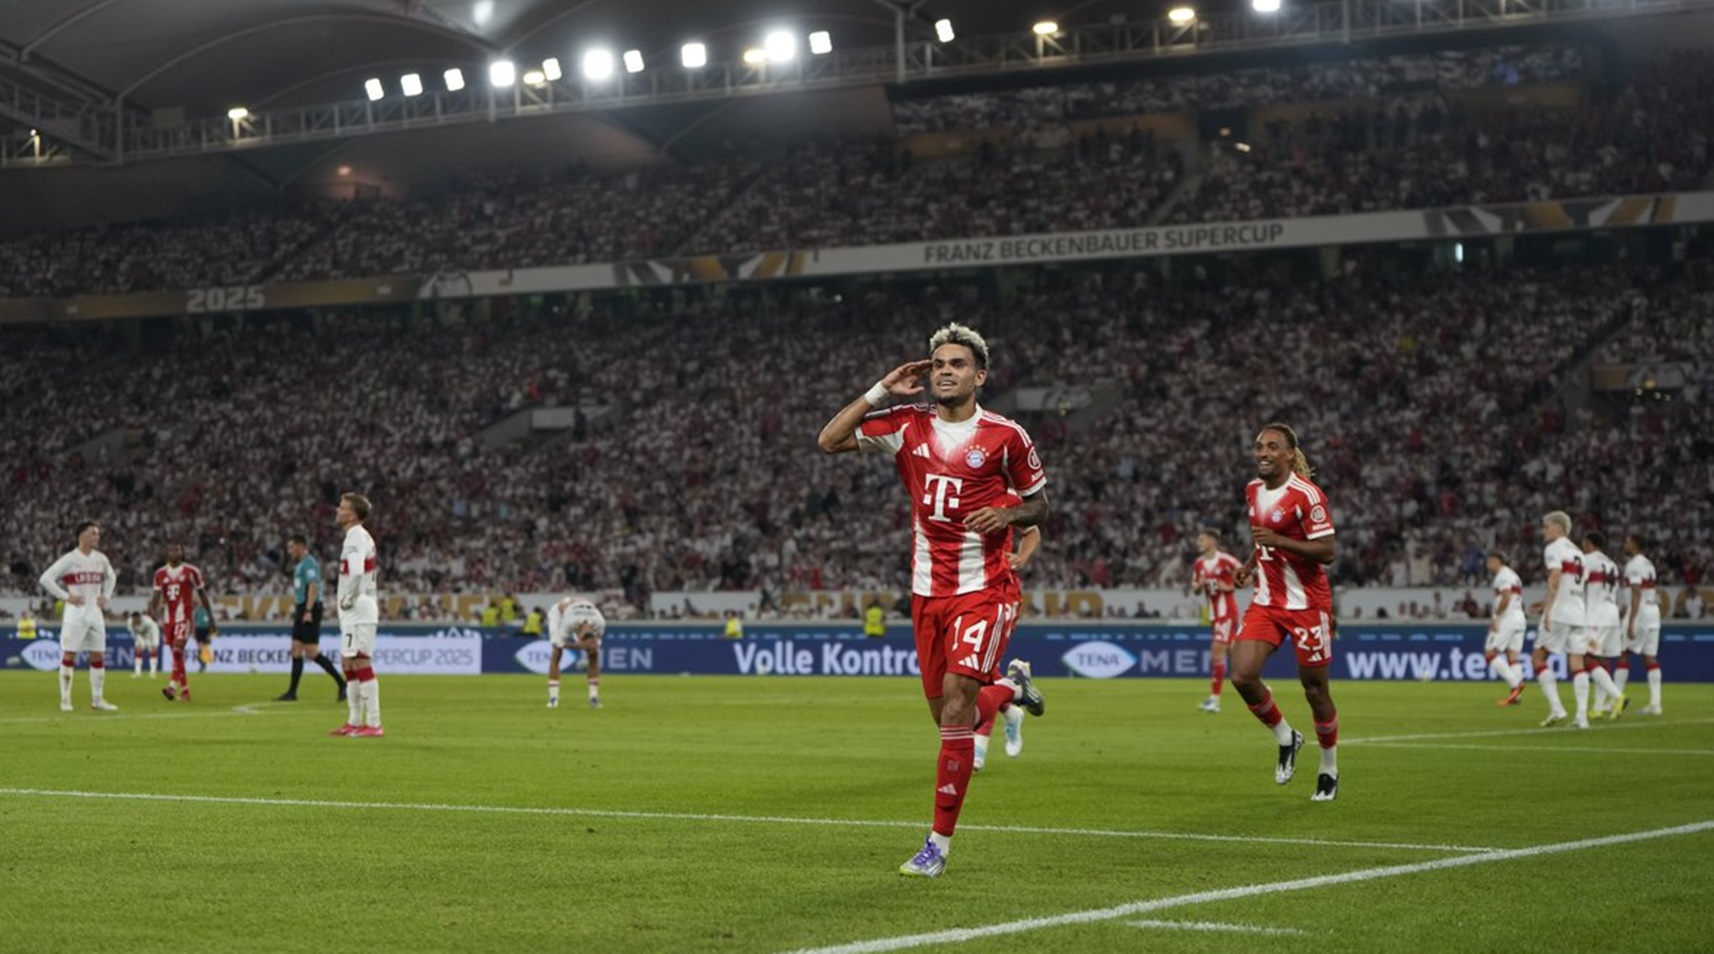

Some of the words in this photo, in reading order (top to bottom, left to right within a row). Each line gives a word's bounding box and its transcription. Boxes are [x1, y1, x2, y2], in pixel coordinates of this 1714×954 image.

[924, 243, 994, 263] FRANZ
[1000, 231, 1158, 259] BECKENBAUER
[1164, 223, 1283, 249] SUPERCUP
[186, 285, 266, 314] 2025
[346, 633, 353, 649] 7
[952, 616, 988, 653] 14
[1294, 624, 1324, 651] 23
[185, 649, 233, 663] FRNZ
[434, 650, 474, 665] 2025
[733, 640, 814, 675] Volle
[822, 642, 922, 675] Kontro
[1077, 653, 1120, 667] TENA
